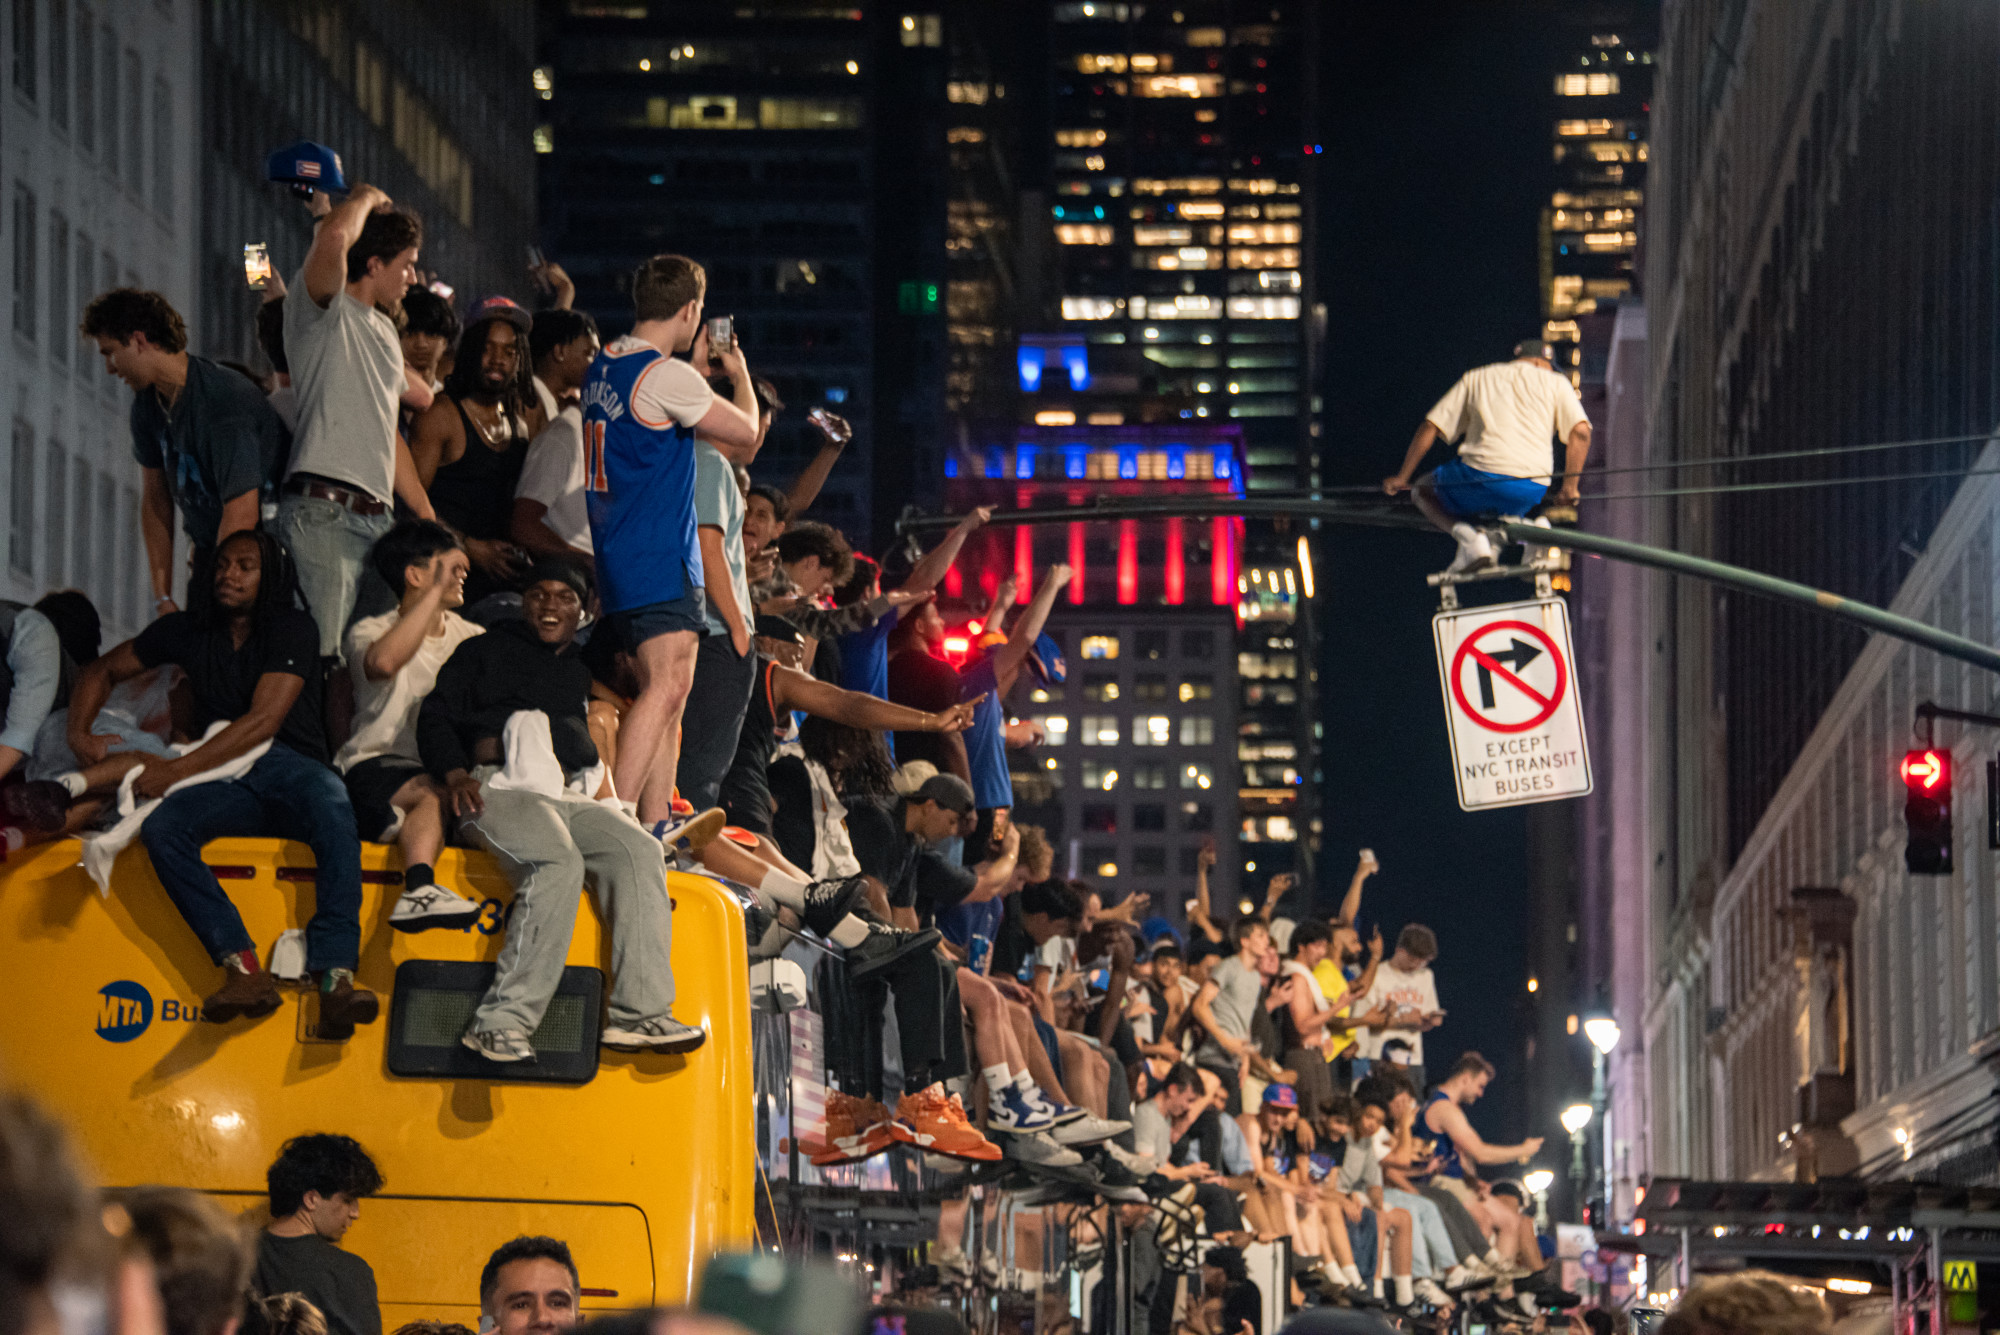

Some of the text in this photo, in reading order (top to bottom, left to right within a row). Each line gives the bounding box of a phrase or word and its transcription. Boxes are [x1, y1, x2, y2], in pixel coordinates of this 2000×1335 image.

[584, 419, 609, 492] 11
[1486, 735, 1551, 758] EXCEPT
[1465, 751, 1577, 779] NYC TRANSIT
[1496, 775, 1554, 795] BUSES
[96, 991, 146, 1031] MTA
